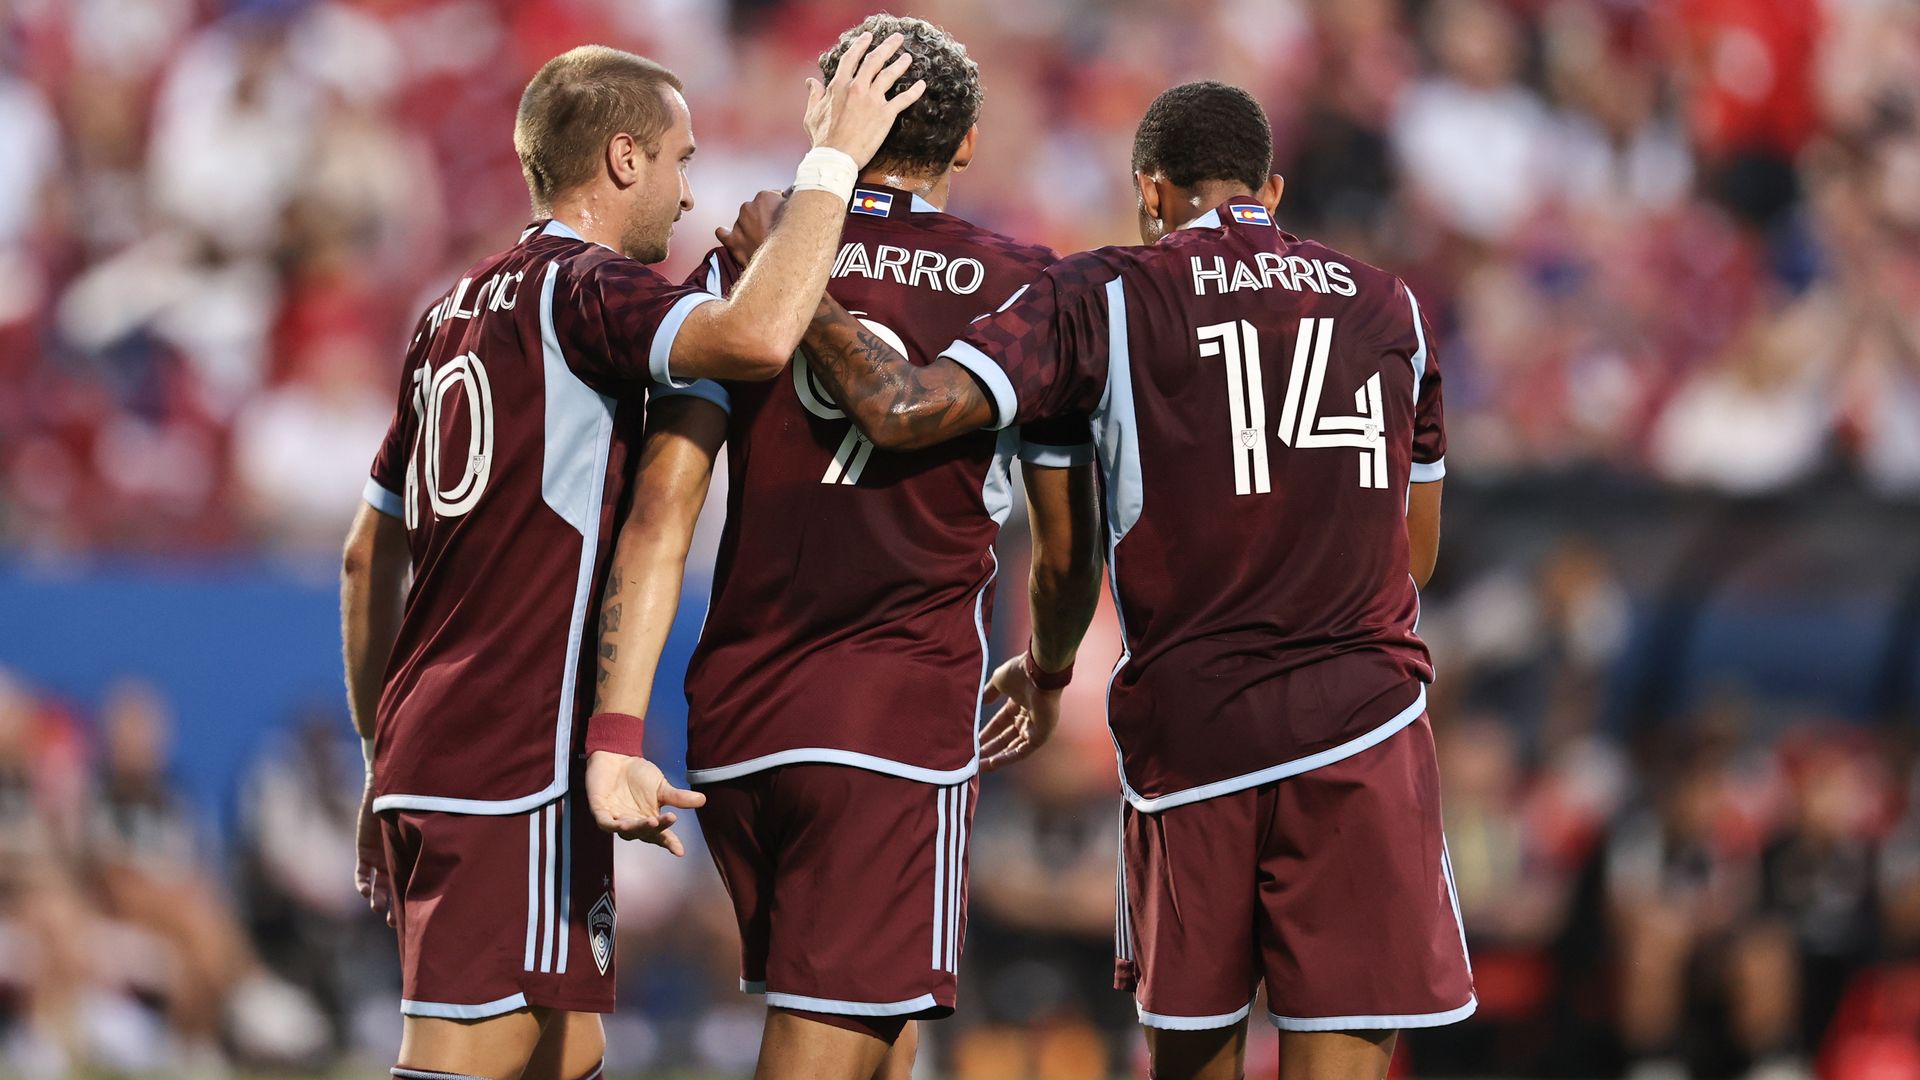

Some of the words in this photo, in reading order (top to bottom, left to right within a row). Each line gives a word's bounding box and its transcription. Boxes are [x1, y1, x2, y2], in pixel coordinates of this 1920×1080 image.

[1190, 252, 1357, 297] HARRIS
[404, 350, 494, 531] 10
[1196, 317, 1389, 496] 14
